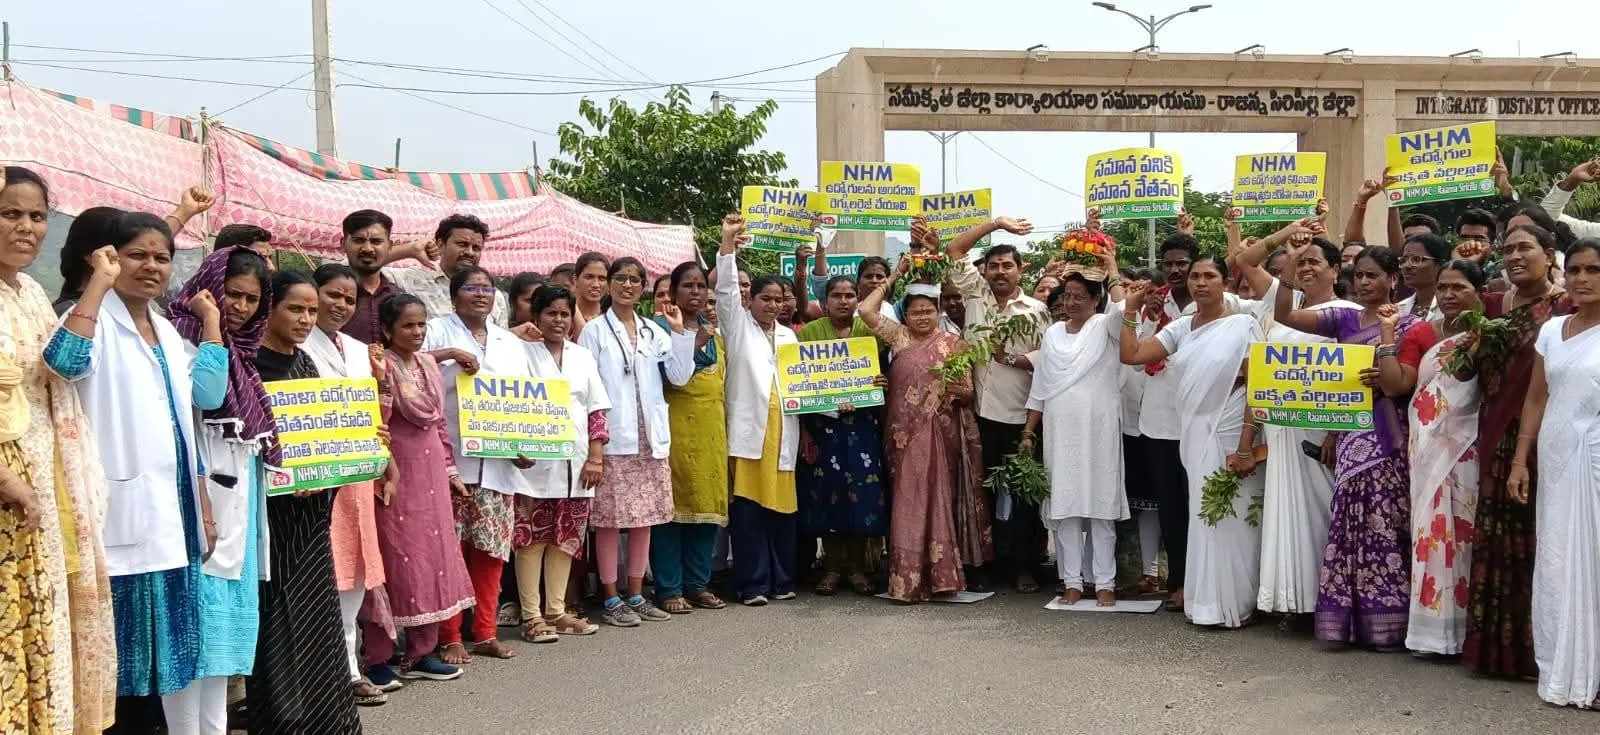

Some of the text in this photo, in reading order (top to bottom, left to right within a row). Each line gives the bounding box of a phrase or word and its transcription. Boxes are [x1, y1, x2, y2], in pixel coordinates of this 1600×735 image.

[888, 86, 954, 112] సమీకృత
[957, 88, 991, 114] జిల్లా
[994, 88, 1098, 113] కార్యాలయాల
[1101, 89, 1206, 111] సముదాయము
[1217, 90, 1268, 115] రాజన్న
[1270, 87, 1318, 117] సిరిసిల్ల
[1322, 90, 1356, 117] జిల్లా
[1499, 97, 1555, 115] DISTRICT
[1400, 128, 1471, 152] NHM
[844, 164, 893, 181] NHM
[1094, 154, 1174, 178] సమాన పనికి
[1251, 155, 1296, 172] NHM
[763, 188, 808, 208] NHM
[1088, 175, 1179, 202] సమాన వేతనం
[923, 193, 975, 211] NHM
[799, 341, 849, 361] NHM
[1265, 345, 1345, 366] NHM
[1273, 366, 1344, 387] ఉద్యోగుల
[320, 384, 375, 409] ఉద్యోగులకు
[473, 377, 548, 400] NHM
[275, 410, 372, 434] వేతనంతో కూడిన
[468, 419, 480, 431] మా
[1272, 410, 1288, 421] NHM
[1288, 411, 1301, 424] JAC
[1307, 411, 1331, 424] Rajanna
[1331, 412, 1353, 423] Siricilla
[282, 443, 311, 459] సూతి
[297, 465, 319, 482] NHM
[319, 464, 336, 482] JAC
